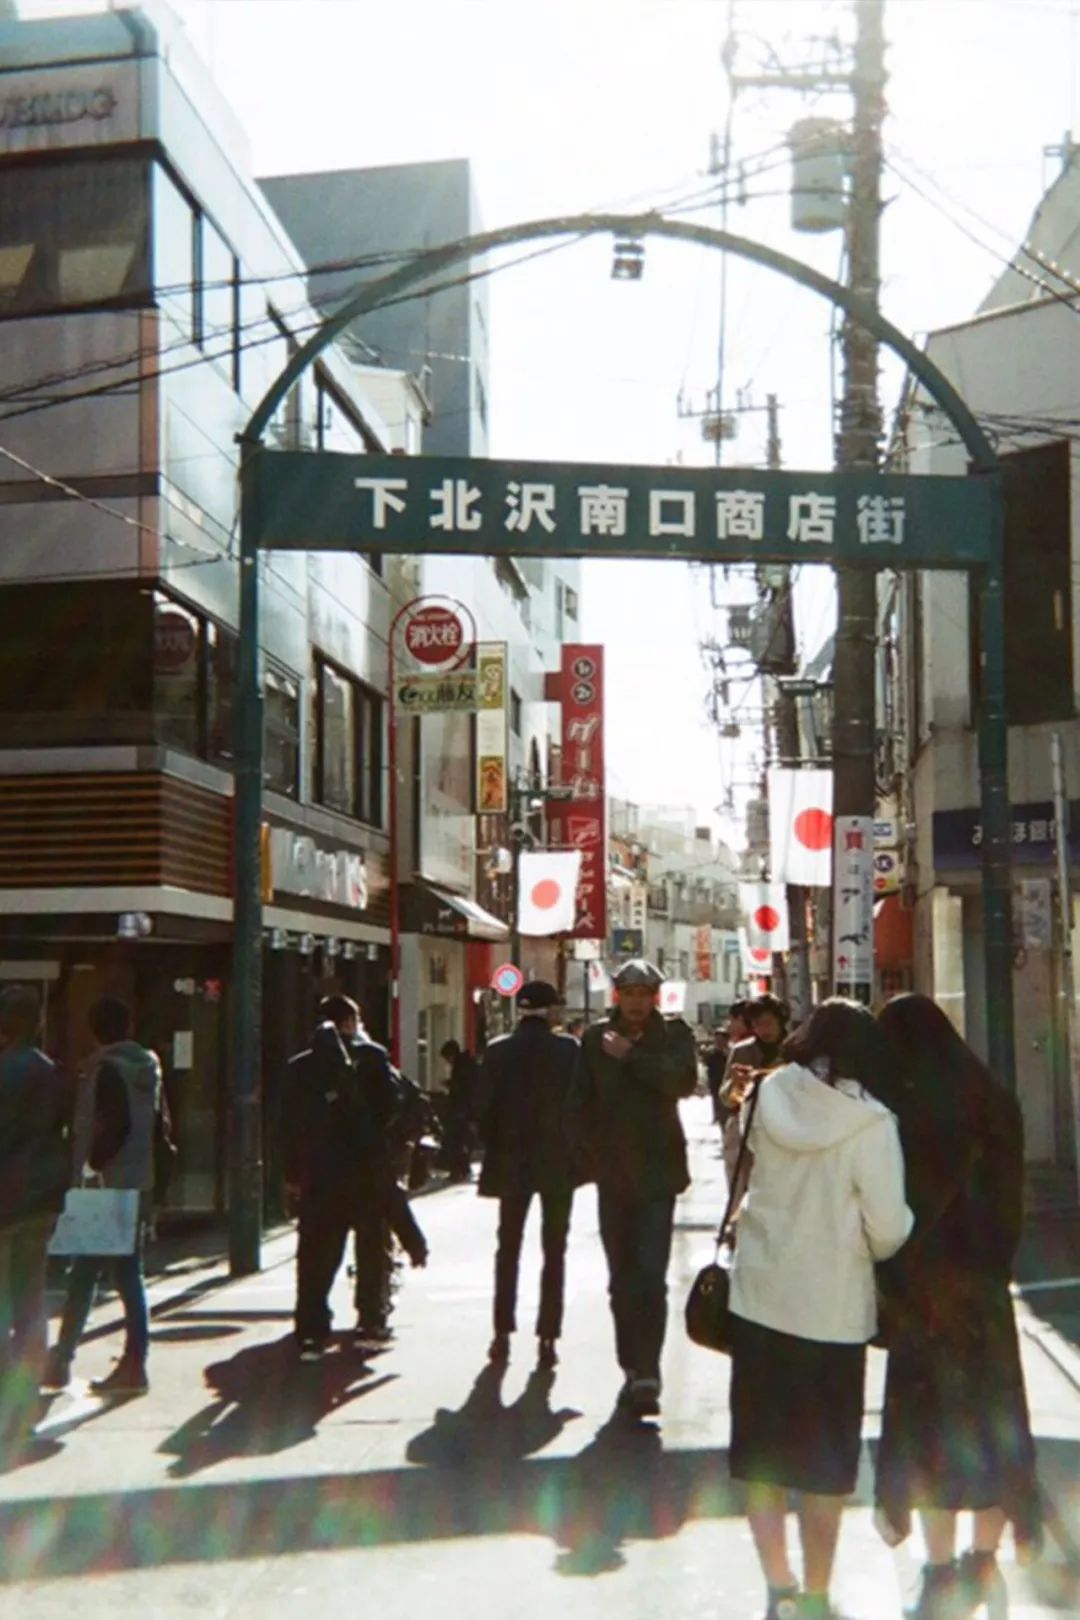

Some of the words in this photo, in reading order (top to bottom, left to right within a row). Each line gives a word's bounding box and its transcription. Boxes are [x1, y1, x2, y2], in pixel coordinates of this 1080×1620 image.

[354, 477, 906, 545] 下北沢南口商店街
[409, 622, 459, 649] 消火栓
